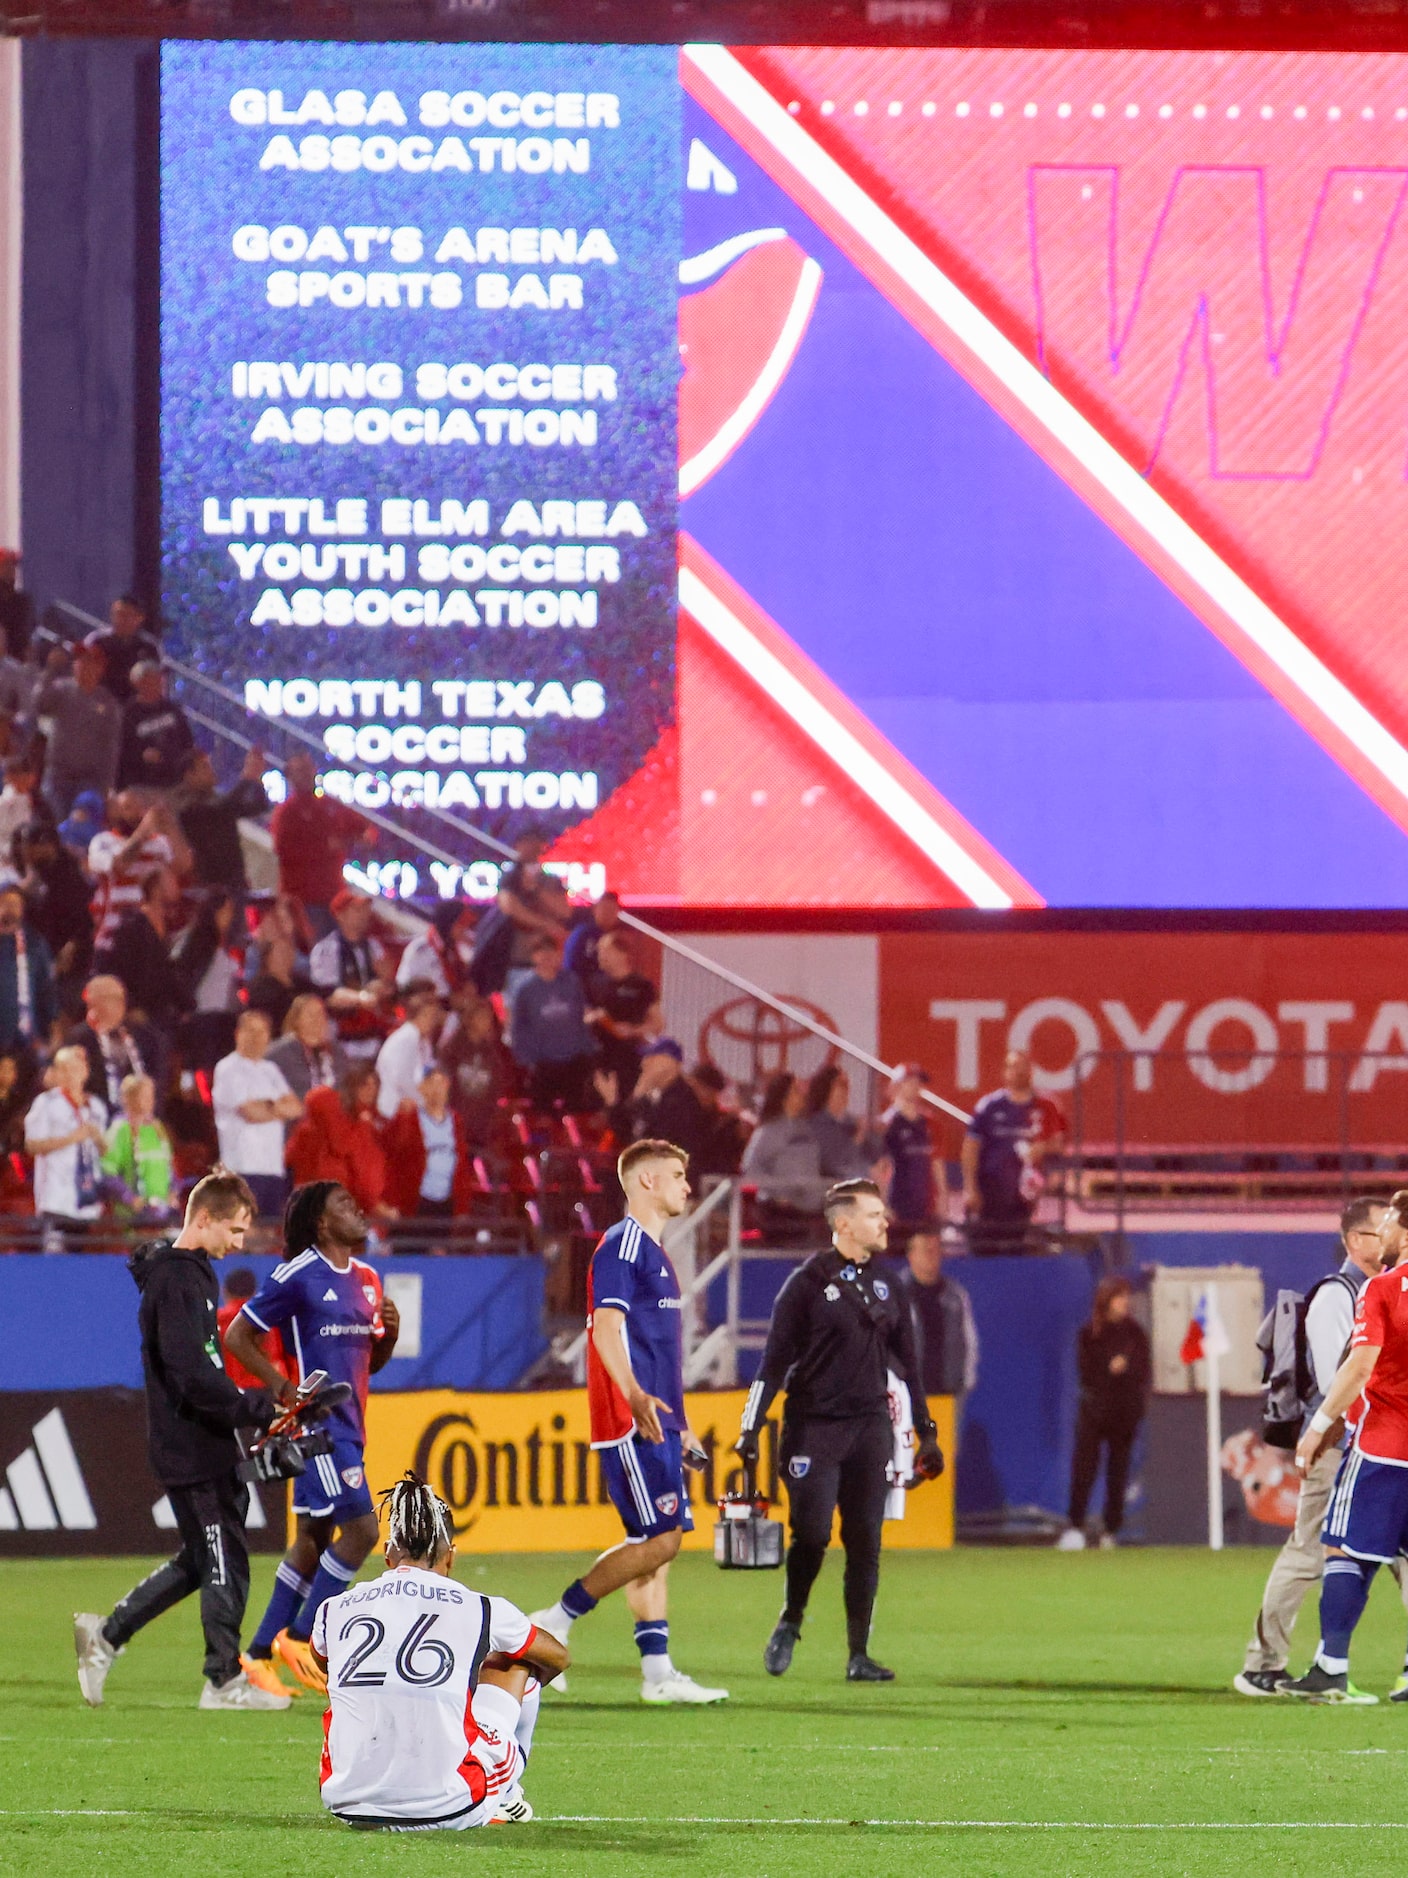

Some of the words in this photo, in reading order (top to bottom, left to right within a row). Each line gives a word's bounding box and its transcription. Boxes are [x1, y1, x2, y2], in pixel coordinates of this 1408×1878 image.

[230, 89, 406, 126] GLASA
[419, 91, 619, 128] SOCCER
[259, 135, 589, 174] ASSOCATION
[232, 224, 424, 263] GOAT'S
[435, 228, 618, 265] ARENA
[266, 270, 462, 308] SPORTS
[476, 272, 583, 309] BAR
[232, 361, 403, 398] IRVING
[416, 362, 618, 400] SOCCER
[251, 407, 597, 445] ASSOCIATION
[203, 498, 367, 535] LITTLE
[382, 499, 489, 536] ELM
[501, 500, 647, 537] AREA
[228, 543, 405, 581] YOUTH
[418, 545, 620, 582] SOCCER
[250, 589, 598, 628] ASSOCIATION
[244, 680, 421, 717] NORTH
[432, 681, 605, 718] TEXAS
[323, 725, 526, 763] SOCCER
[337, 1613, 456, 1689] 26
